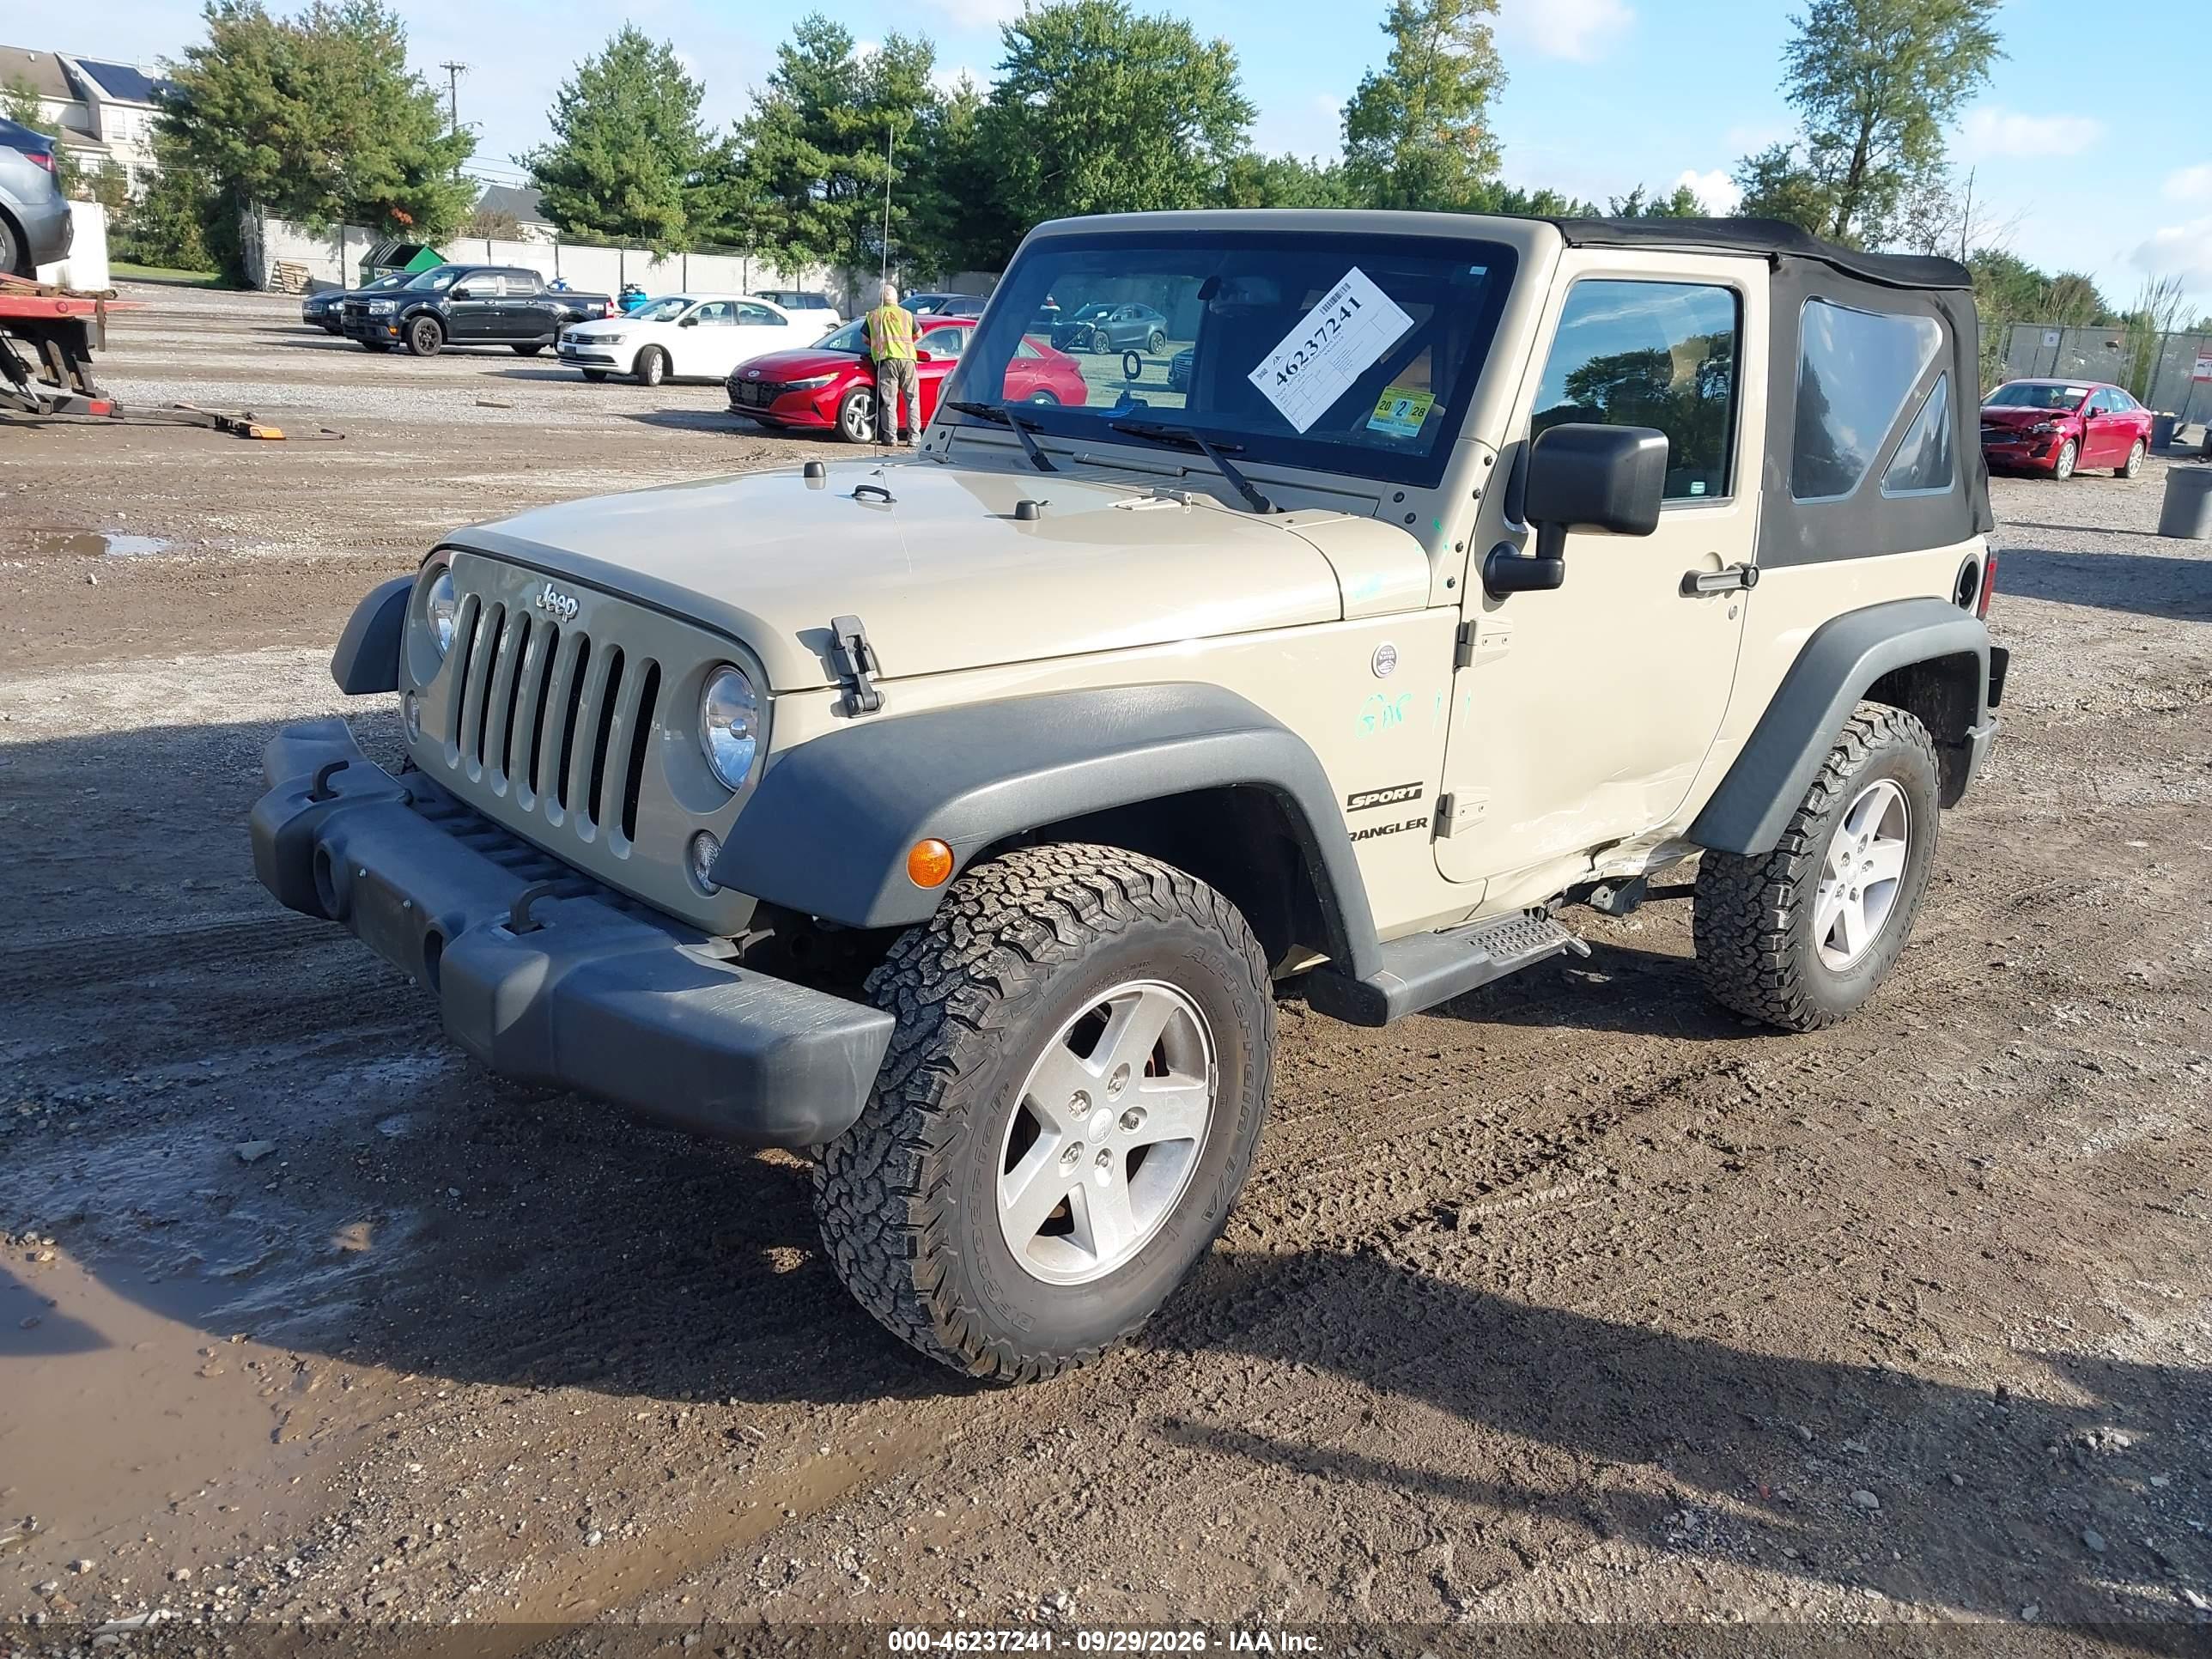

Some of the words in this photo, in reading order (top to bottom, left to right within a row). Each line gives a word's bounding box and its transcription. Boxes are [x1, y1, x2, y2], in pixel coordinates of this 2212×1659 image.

[1275, 296, 1363, 388] 46237241
[1379, 400, 1392, 411] 20
[1395, 401, 1407, 416] 2
[1412, 406, 1425, 417] 28
[536, 583, 579, 623] Jeep
[1348, 787, 1421, 809] SPORT
[1347, 817, 1428, 842] RANGLER
[1182, 946, 1255, 1135] All-Terrain
